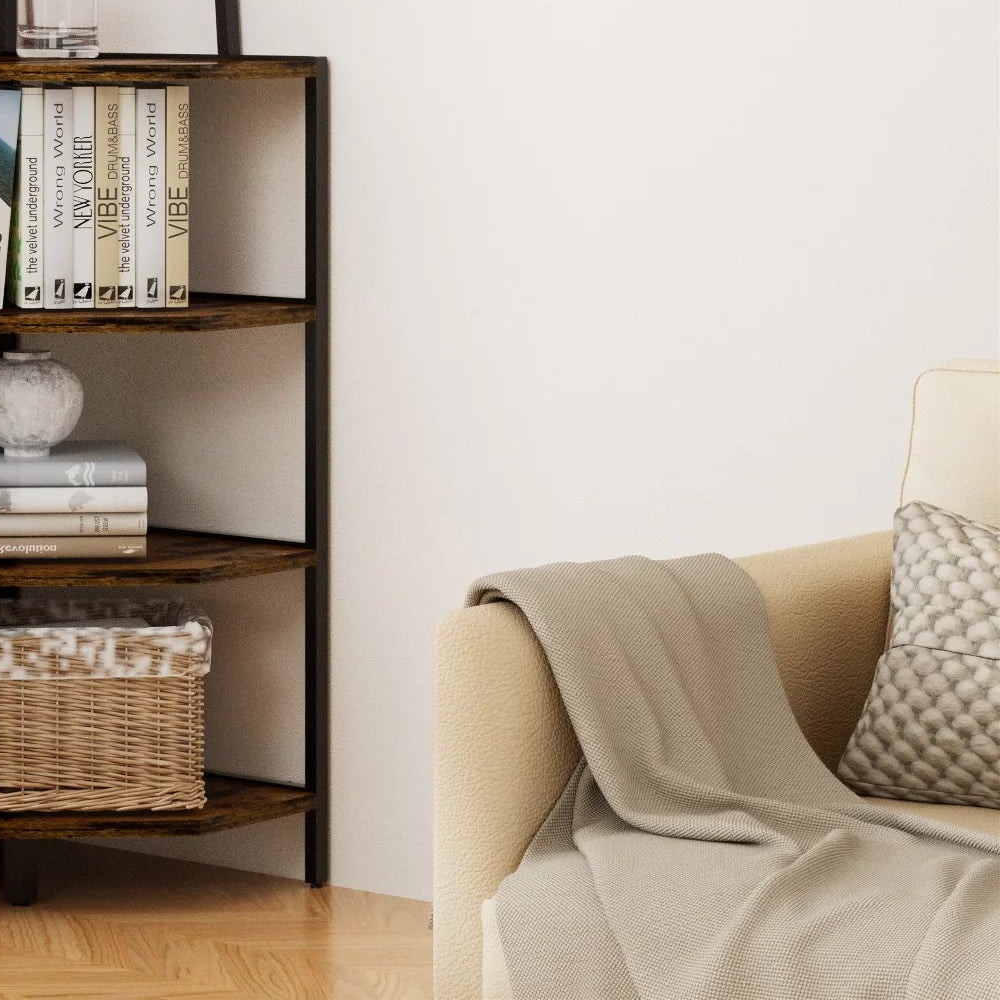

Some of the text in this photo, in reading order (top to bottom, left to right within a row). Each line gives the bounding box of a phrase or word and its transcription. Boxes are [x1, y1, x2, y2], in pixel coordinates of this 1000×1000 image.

[26, 157, 40, 274] the velvet underground
[54, 103, 65, 228] Wrong World
[98, 103, 118, 239] VIBE DRUM&BASS
[118, 156, 133, 272] the velvet underground
[146, 103, 158, 227] Wrong World
[168, 103, 189, 239] VIBE DRUM&BASS
